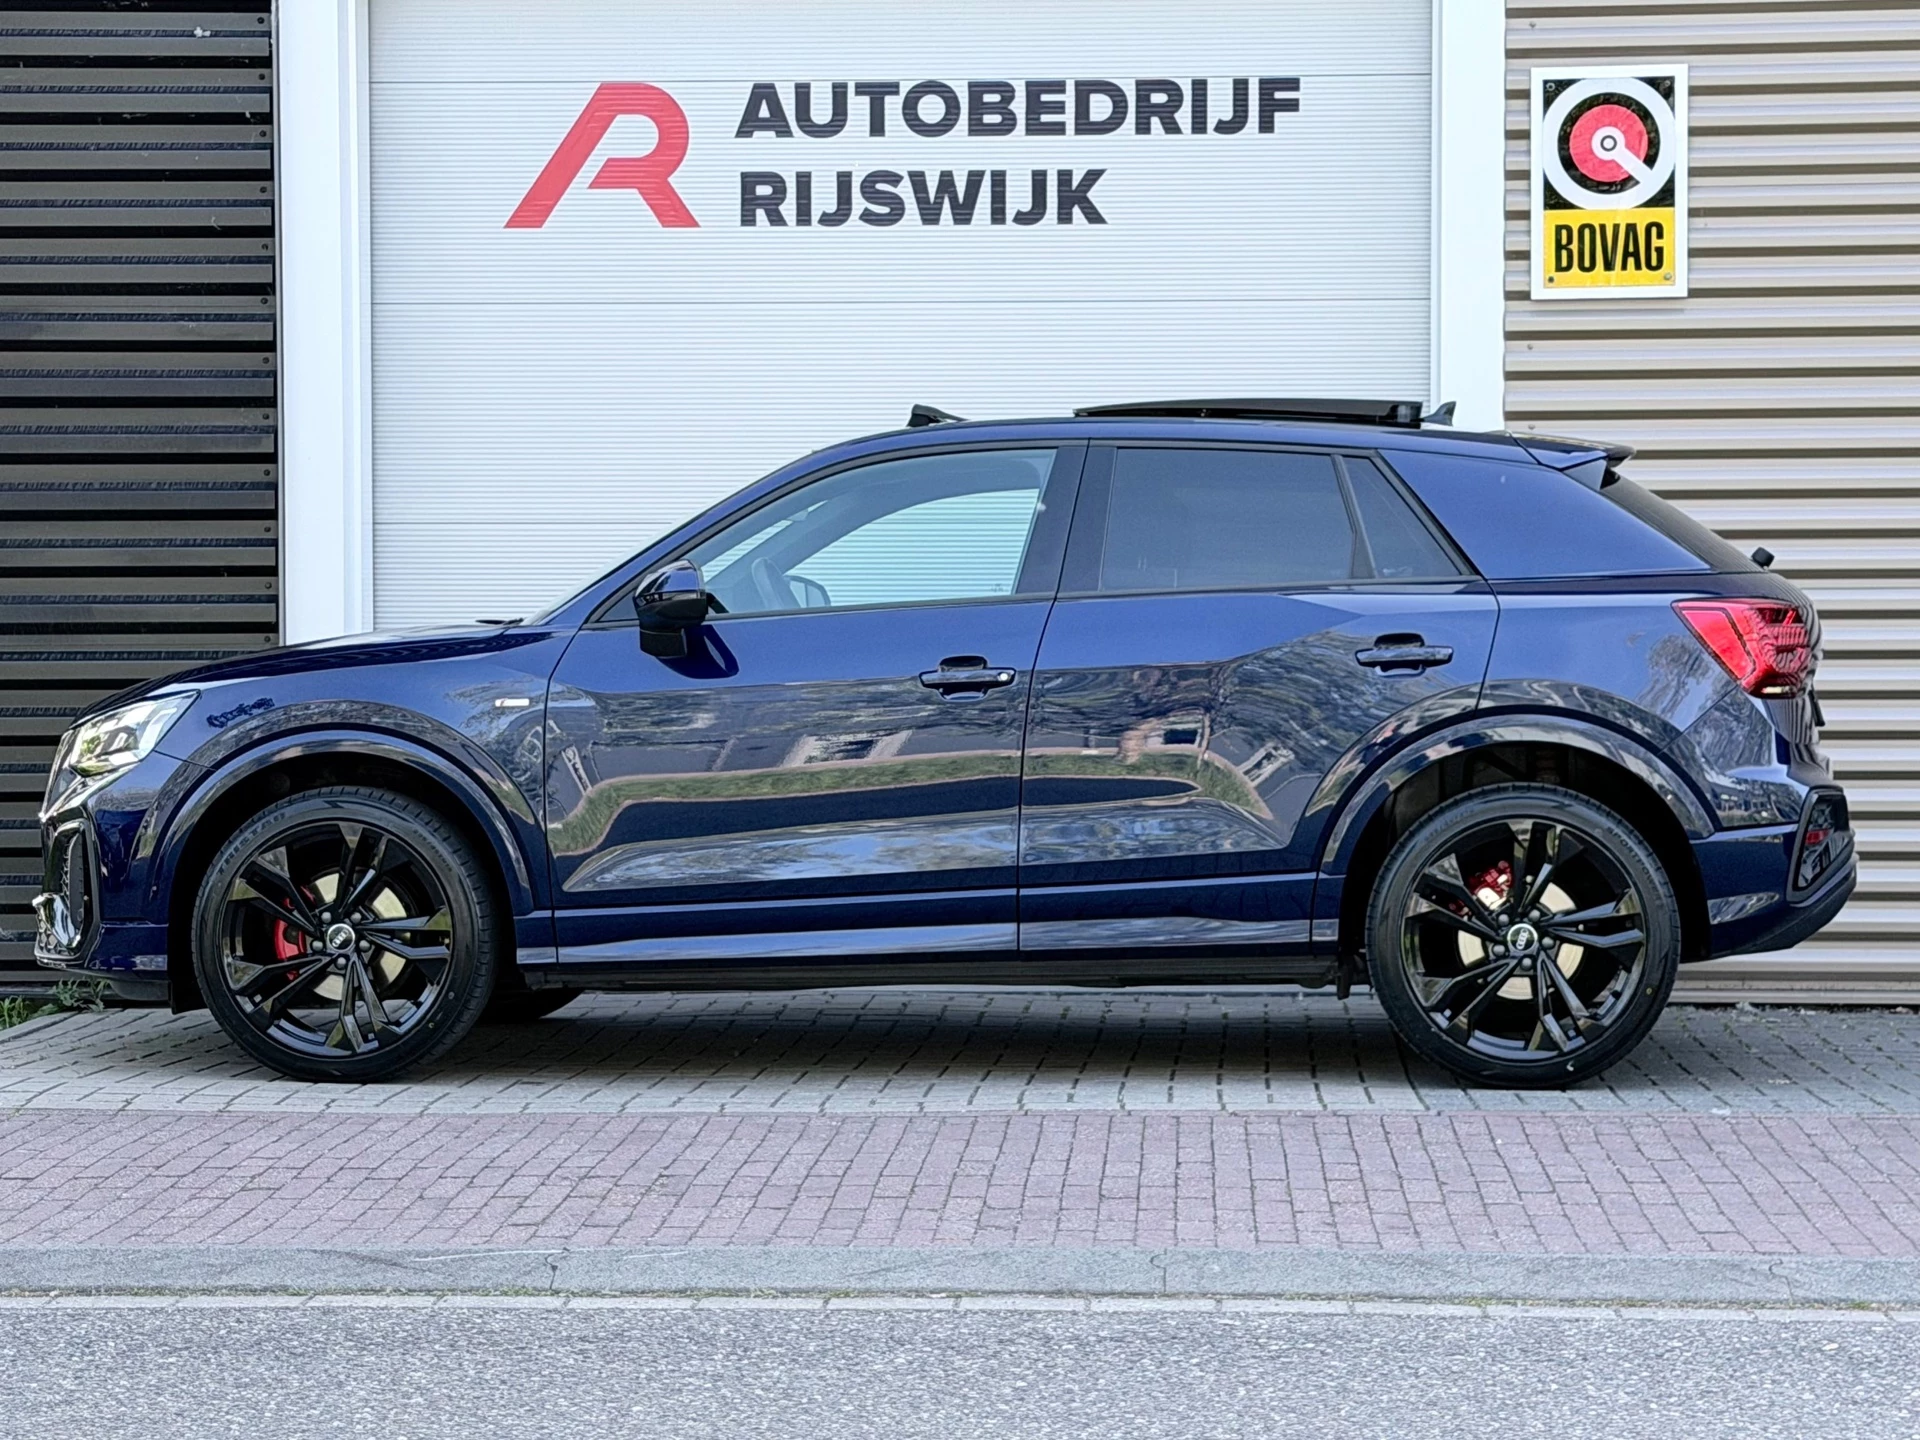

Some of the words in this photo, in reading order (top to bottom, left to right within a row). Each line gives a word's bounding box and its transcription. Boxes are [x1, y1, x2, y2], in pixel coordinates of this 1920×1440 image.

[734, 77, 1301, 138] AUTOBEDRIJF
[740, 169, 1109, 229] RIJSWIJK
[1554, 221, 1664, 273] BOVAG
